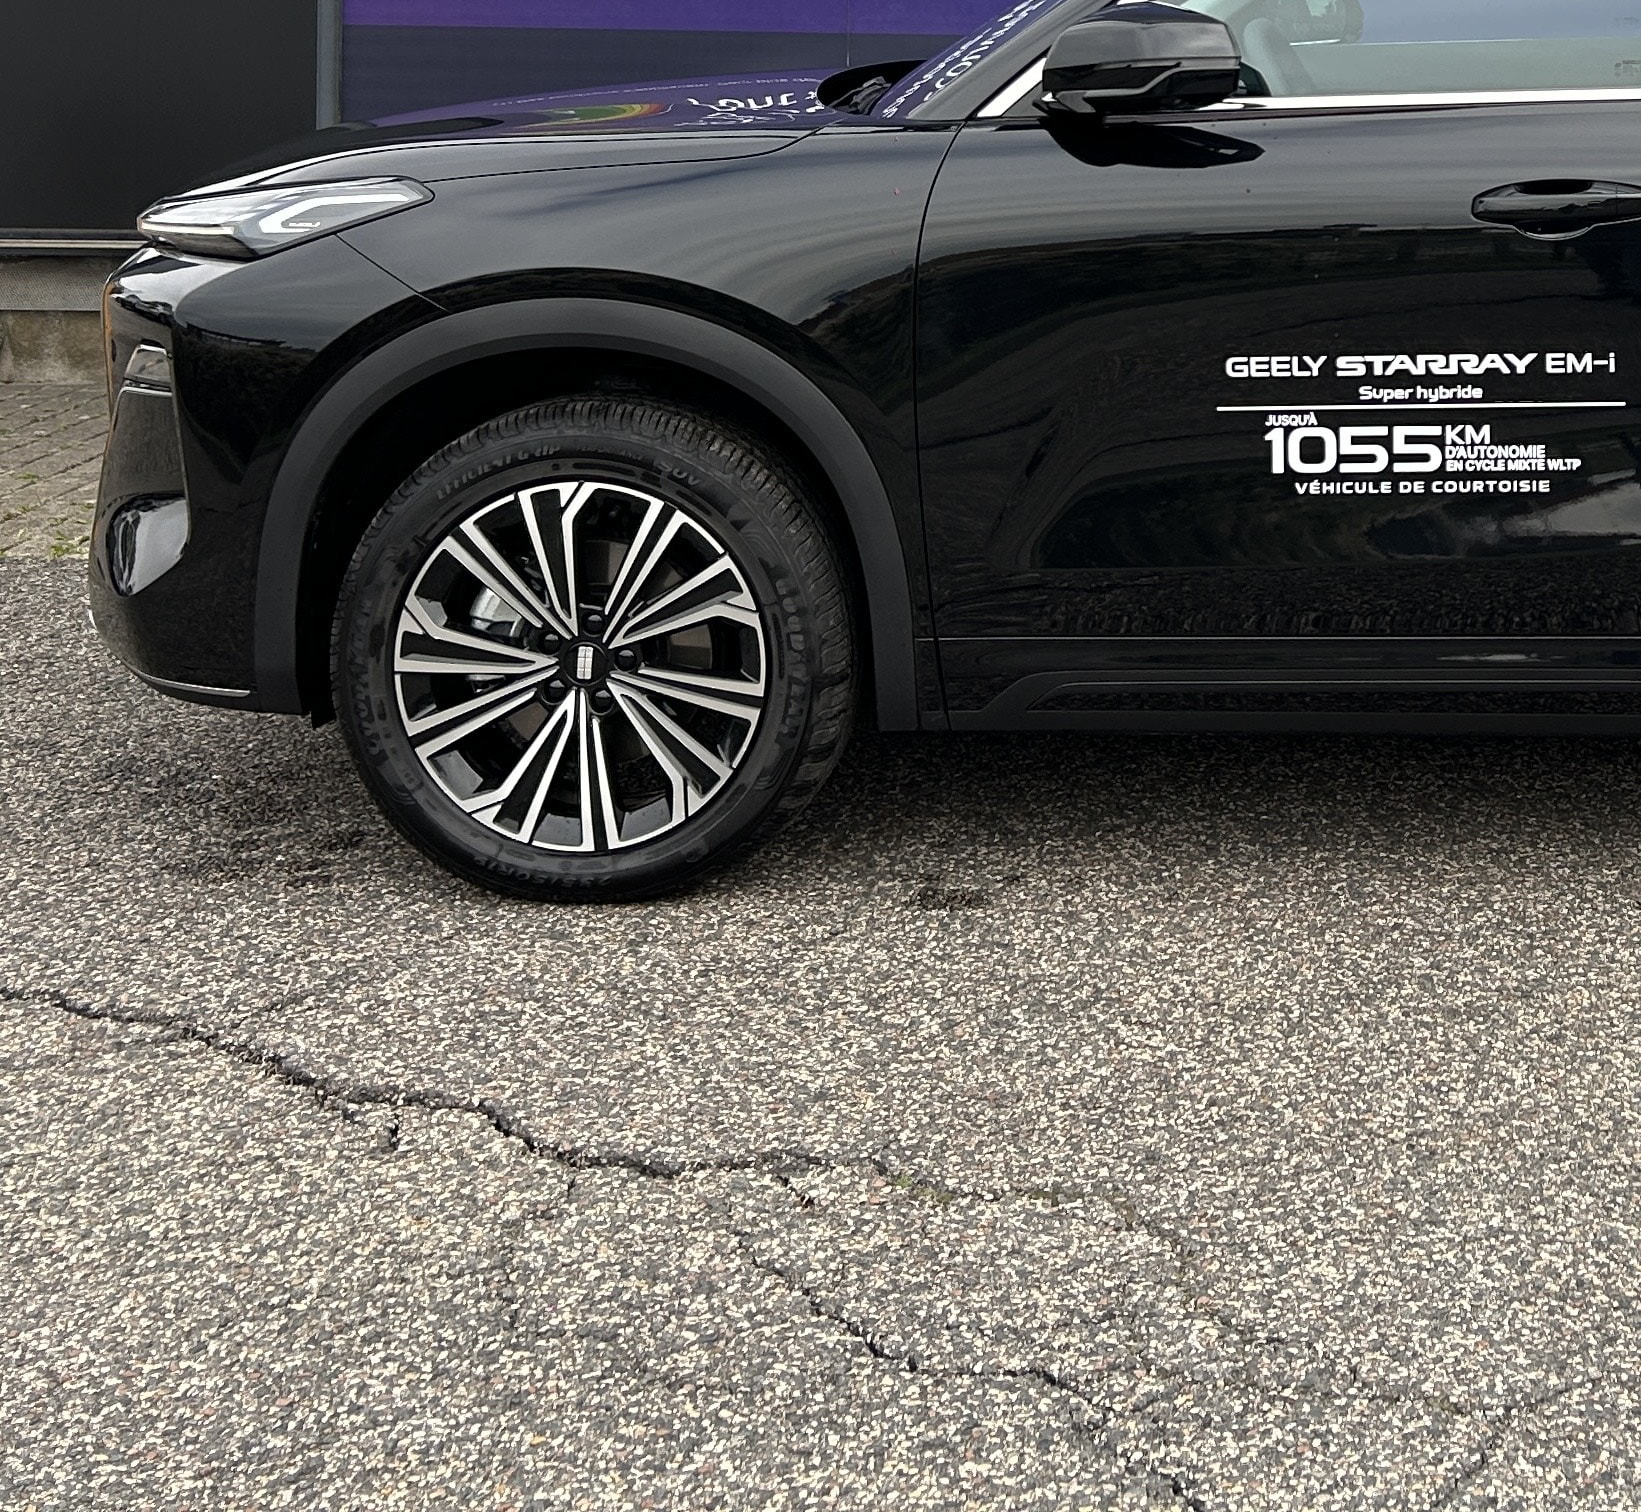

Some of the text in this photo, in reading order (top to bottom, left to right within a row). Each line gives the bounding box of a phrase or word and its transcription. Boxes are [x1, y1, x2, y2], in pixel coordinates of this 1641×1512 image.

[1225, 352, 1616, 378] GEELY STARRAY EM-i
[1358, 384, 1483, 403] Super hybride
[1264, 424, 1491, 474] 1055 KM
[1445, 444, 1546, 460] D'AUTONOMIE
[1445, 458, 1582, 472] EN CYCLE MIXTE WLTP
[1294, 479, 1551, 495] VÉHICULE DE COURTOISIE
